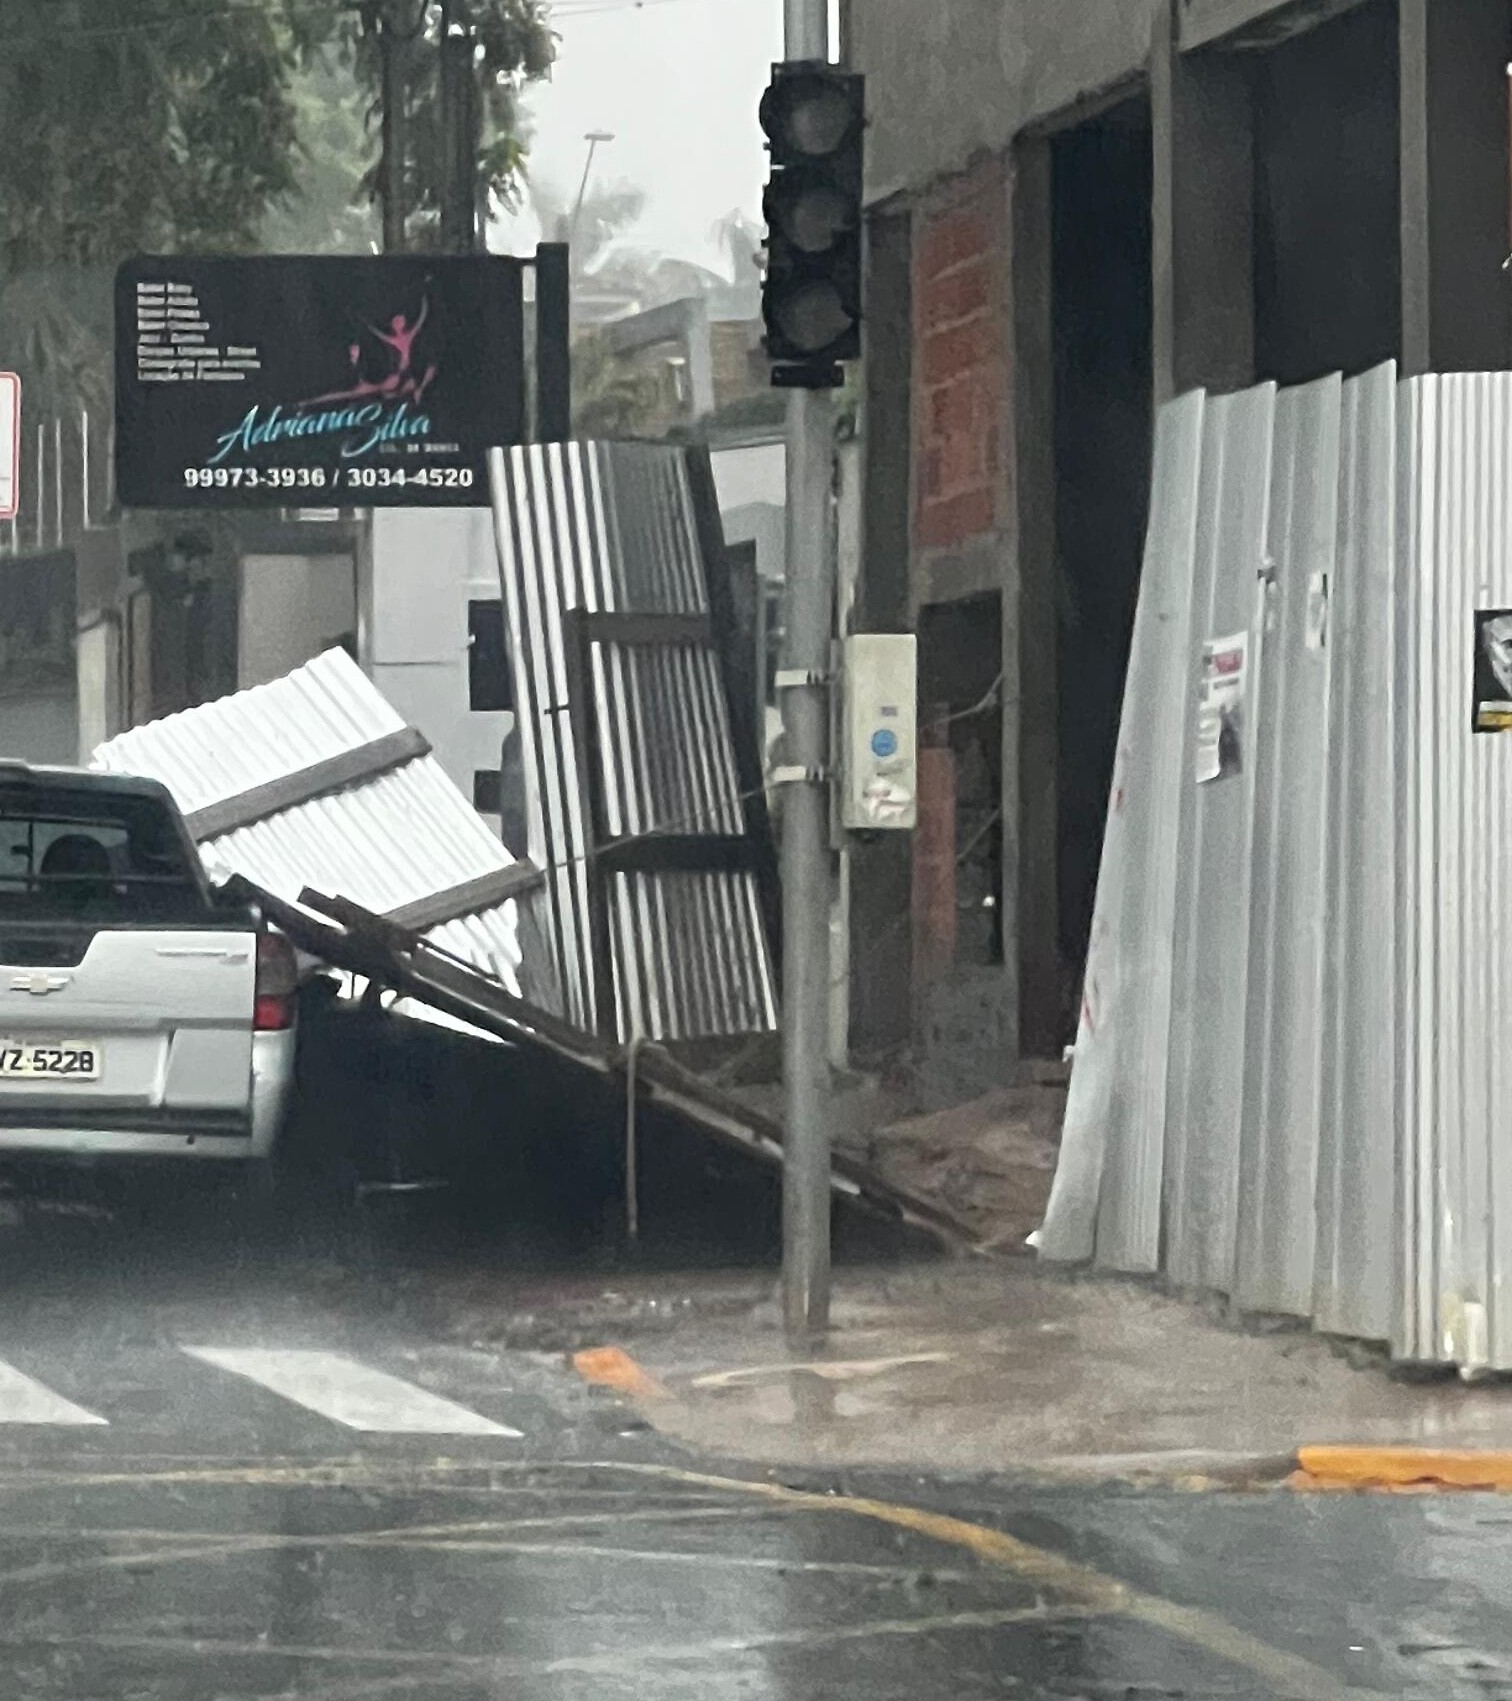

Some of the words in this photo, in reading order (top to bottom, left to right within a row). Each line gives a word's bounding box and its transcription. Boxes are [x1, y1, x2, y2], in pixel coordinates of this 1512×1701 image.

[206, 404, 361, 464] Adriana
[341, 403, 430, 457] Silva
[184, 467, 326, 487] 99973-3936
[332, 467, 340, 487] /
[347, 467, 474, 487] 3034-4520
